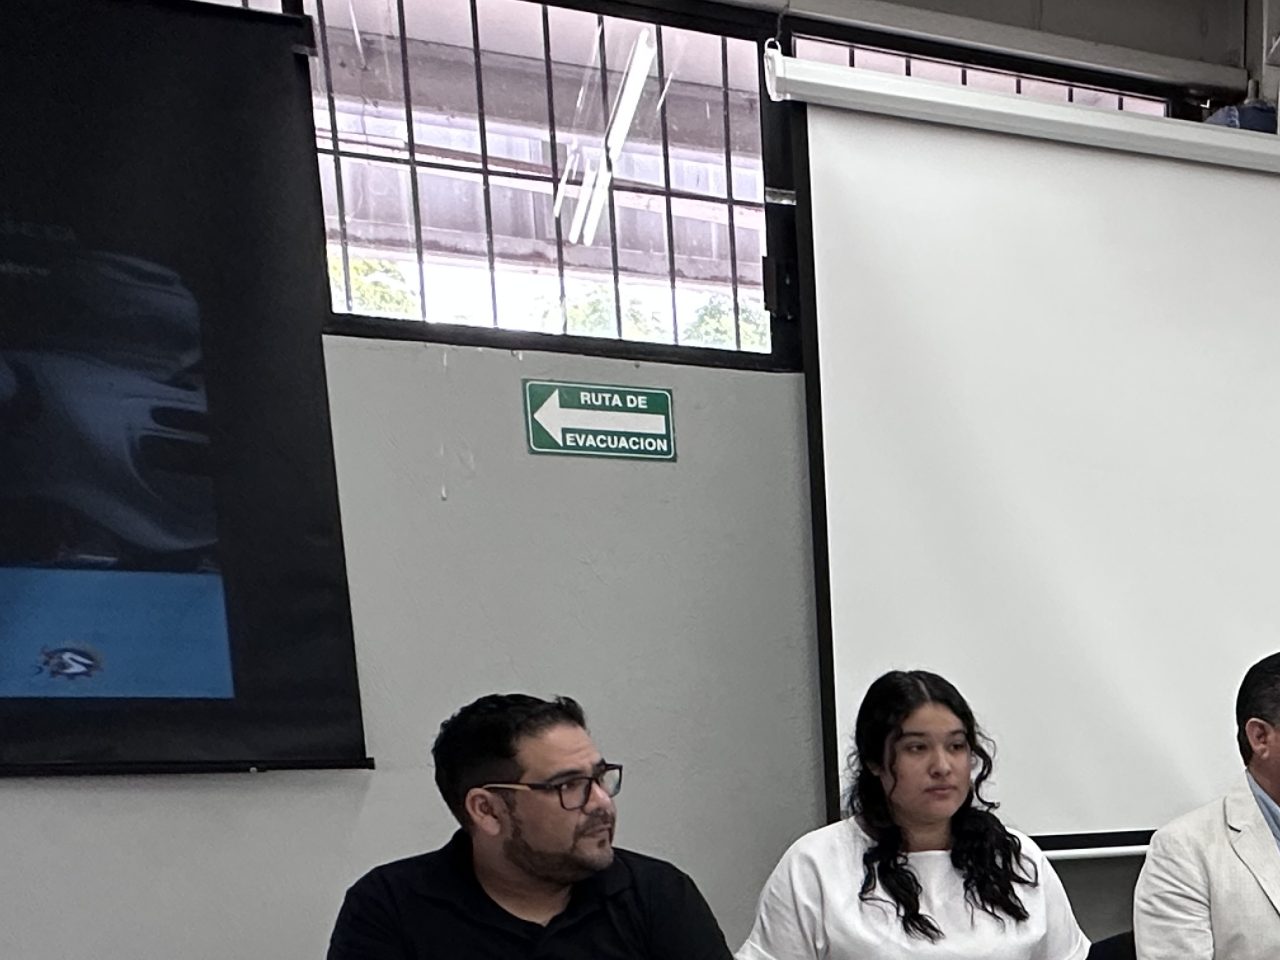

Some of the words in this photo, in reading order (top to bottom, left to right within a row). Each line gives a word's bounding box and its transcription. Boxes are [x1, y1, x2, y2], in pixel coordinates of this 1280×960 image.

[579, 391, 623, 408] RUTA
[626, 394, 648, 409] DE
[565, 433, 668, 452] EVACUACION
